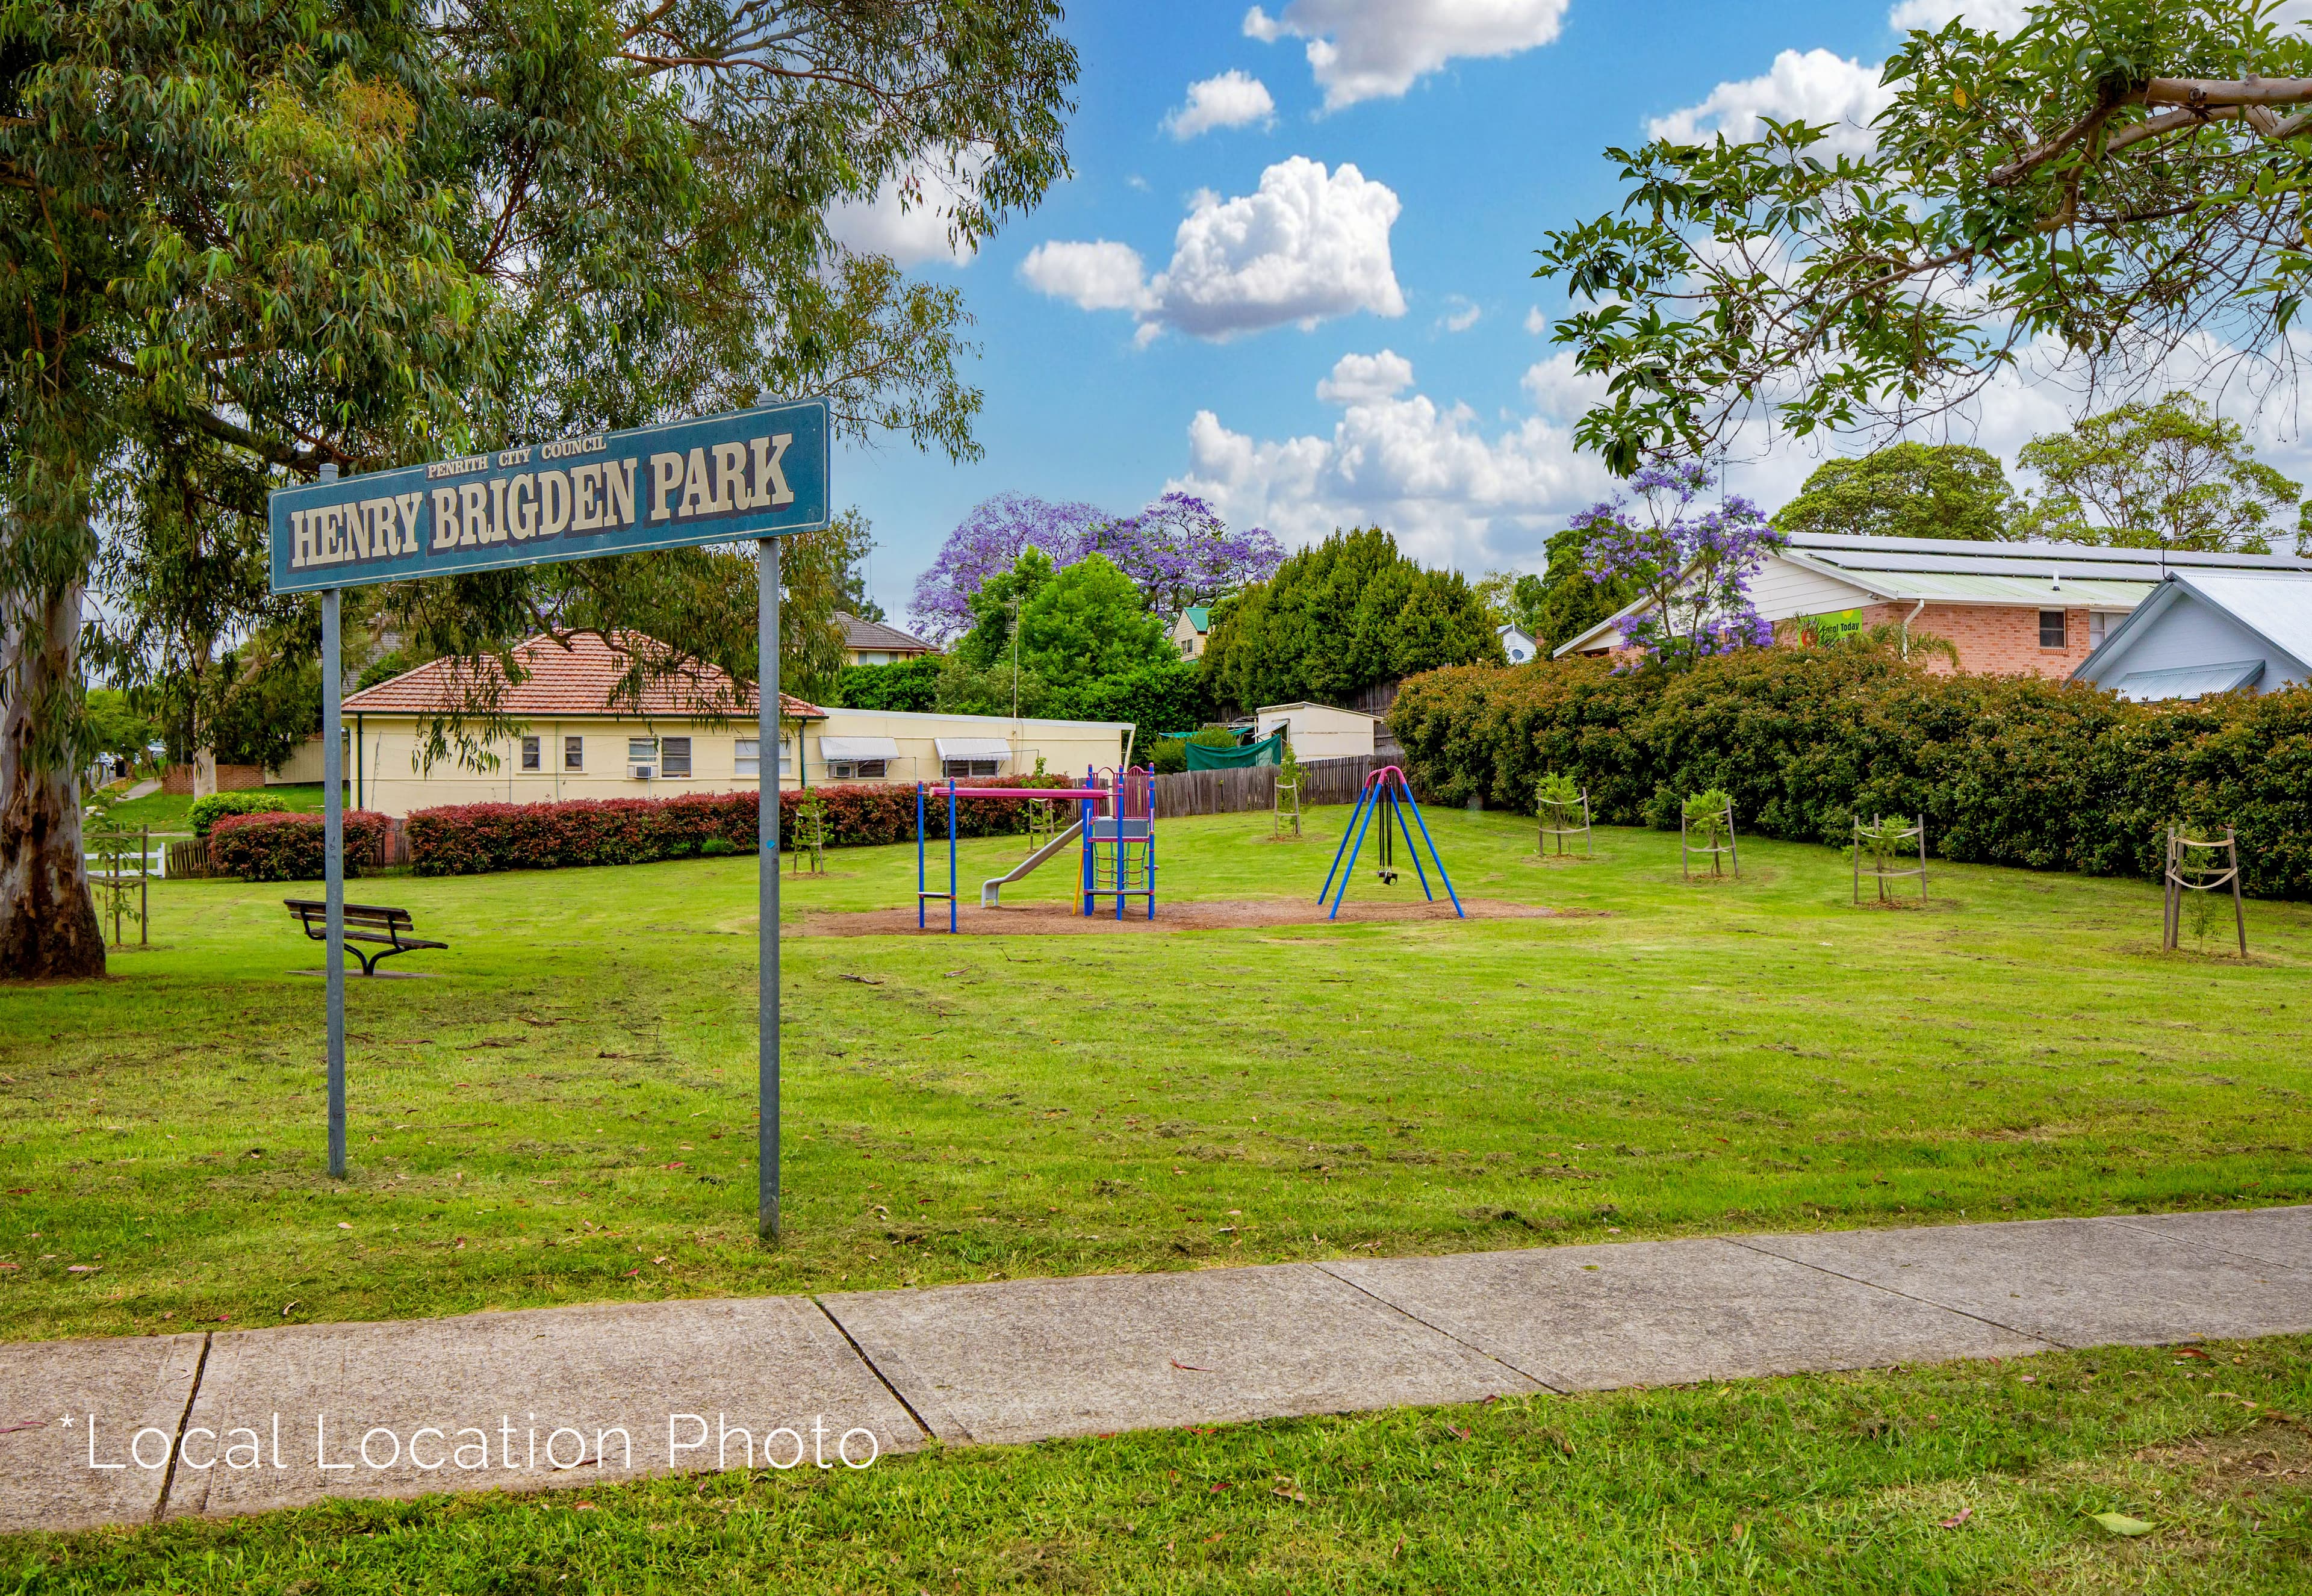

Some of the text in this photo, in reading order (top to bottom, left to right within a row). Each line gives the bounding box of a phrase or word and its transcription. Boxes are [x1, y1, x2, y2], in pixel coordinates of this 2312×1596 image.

[427, 435, 607, 479] PENRITH CITY COUNCIL
[290, 433, 795, 568] HENRY BRIGDEN PARK
[1841, 622, 1859, 632] Today
